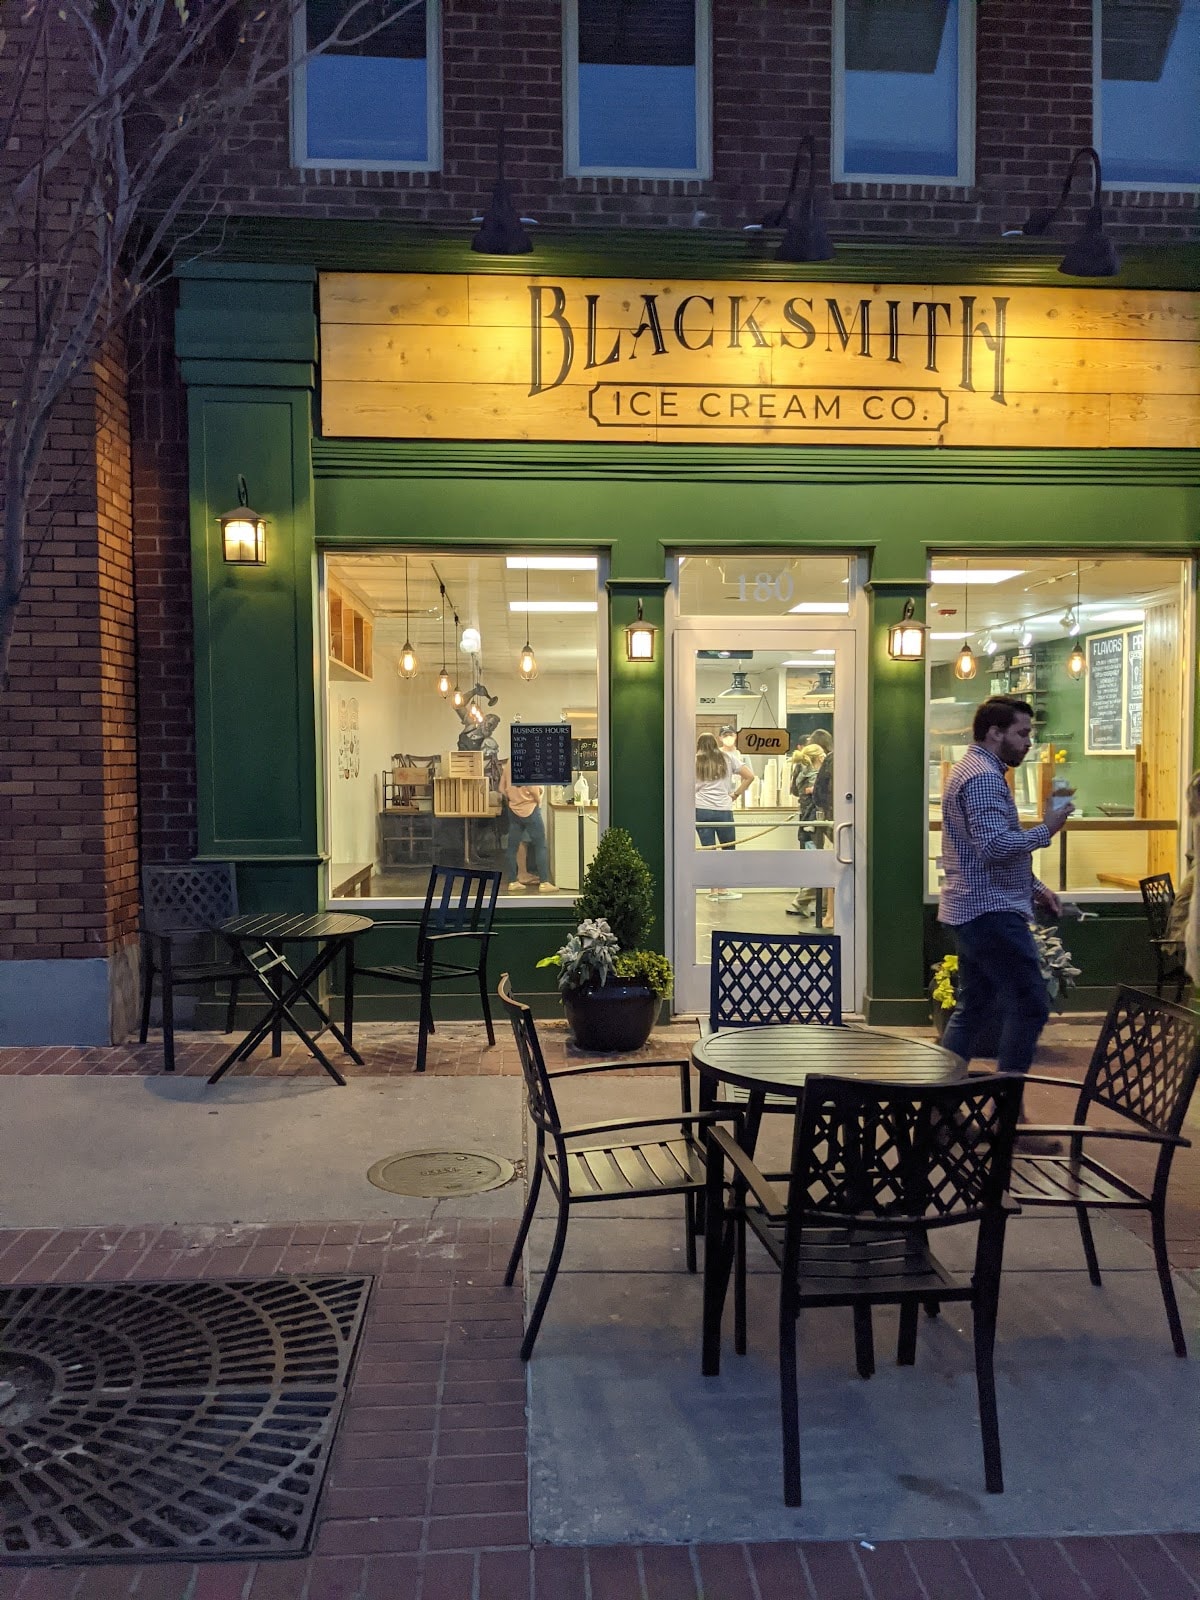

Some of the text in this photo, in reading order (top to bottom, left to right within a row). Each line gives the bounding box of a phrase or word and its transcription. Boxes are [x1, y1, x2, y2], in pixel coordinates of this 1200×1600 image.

[527, 285, 1011, 407] BLACKSMITH
[614, 391, 929, 422] ICE CREAM CO.
[738, 573, 794, 602] 180
[1093, 638, 1122, 656] FLAVORS
[746, 734, 781, 751] Open
